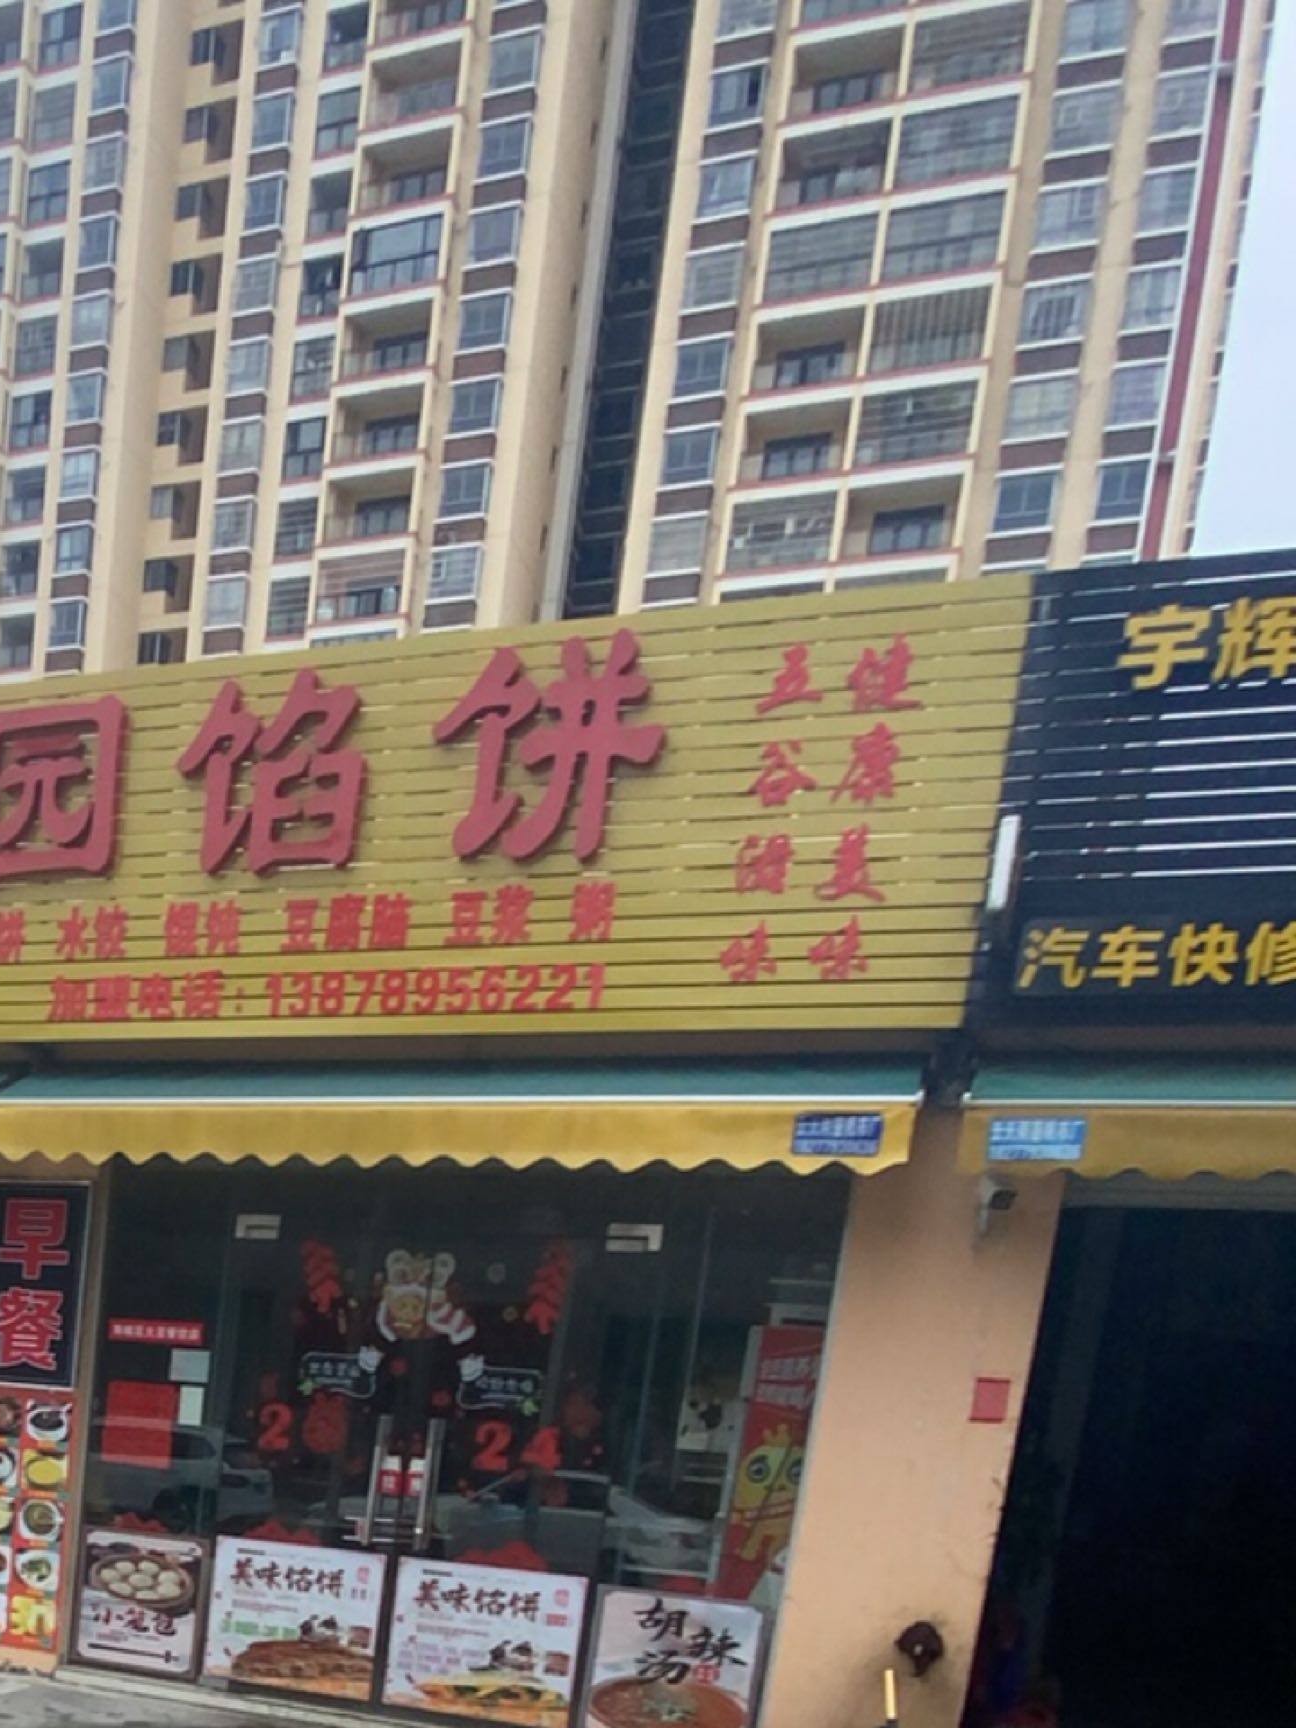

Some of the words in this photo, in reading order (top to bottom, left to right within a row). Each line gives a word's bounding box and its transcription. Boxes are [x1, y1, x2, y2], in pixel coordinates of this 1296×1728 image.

[807, 633, 923, 981] 健康美味
[55, 906, 129, 960] 水饺
[163, 899, 241, 958] 馄饨
[281, 893, 411, 952] 豆腐脑
[444, 884, 533, 946] 豆浆
[1017, 920, 1296, 989] 汽车快修
